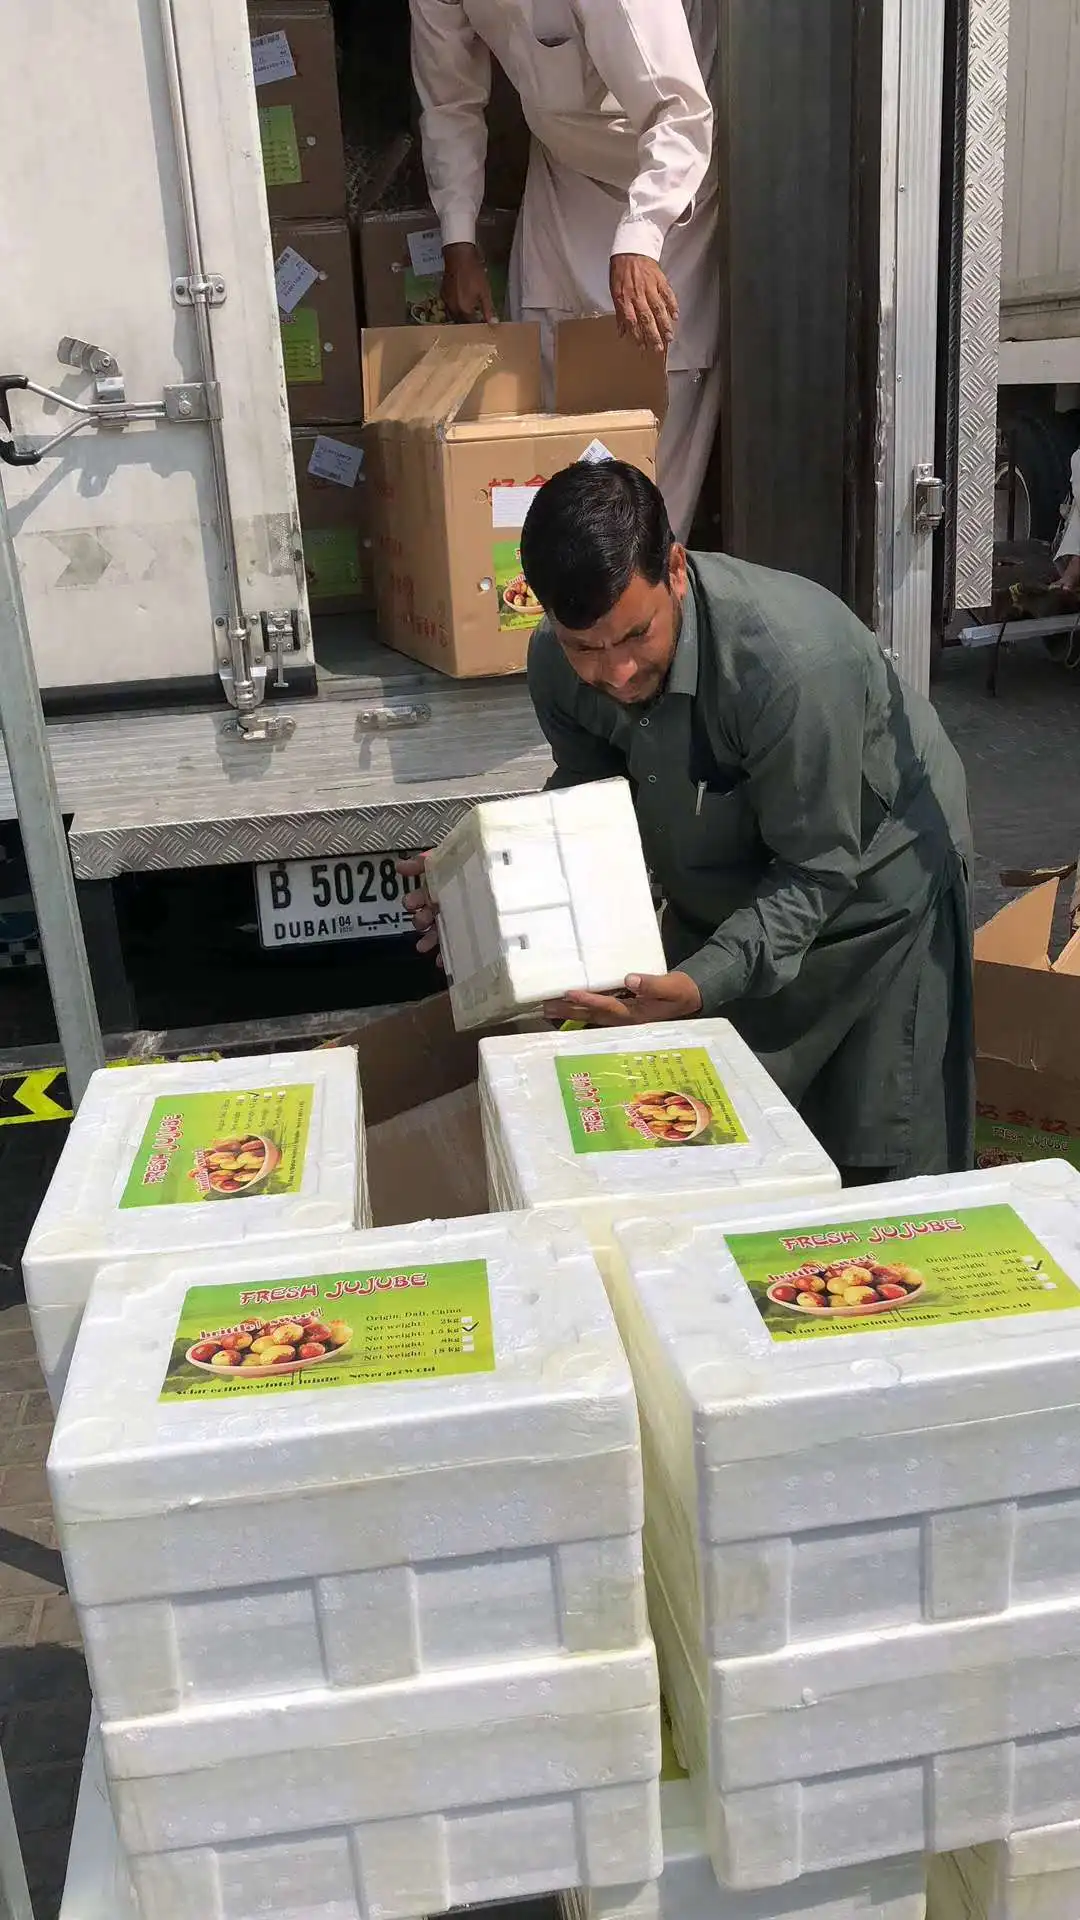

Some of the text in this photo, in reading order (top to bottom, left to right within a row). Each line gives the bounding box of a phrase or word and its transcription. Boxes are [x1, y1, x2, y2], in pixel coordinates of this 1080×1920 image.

[269, 870, 292, 909] B
[274, 918, 338, 940] DUBAI
[339, 915, 351, 927] 04
[569, 1071, 606, 1134] FRESH JUJUBE
[142, 1113, 184, 1185] FRESH JUJUBE
[1026, 1135, 1069, 1152] JUJUBE
[781, 1217, 967, 1252] FRESH JUJUBE
[239, 1272, 428, 1306] FRESH JUJUBE
